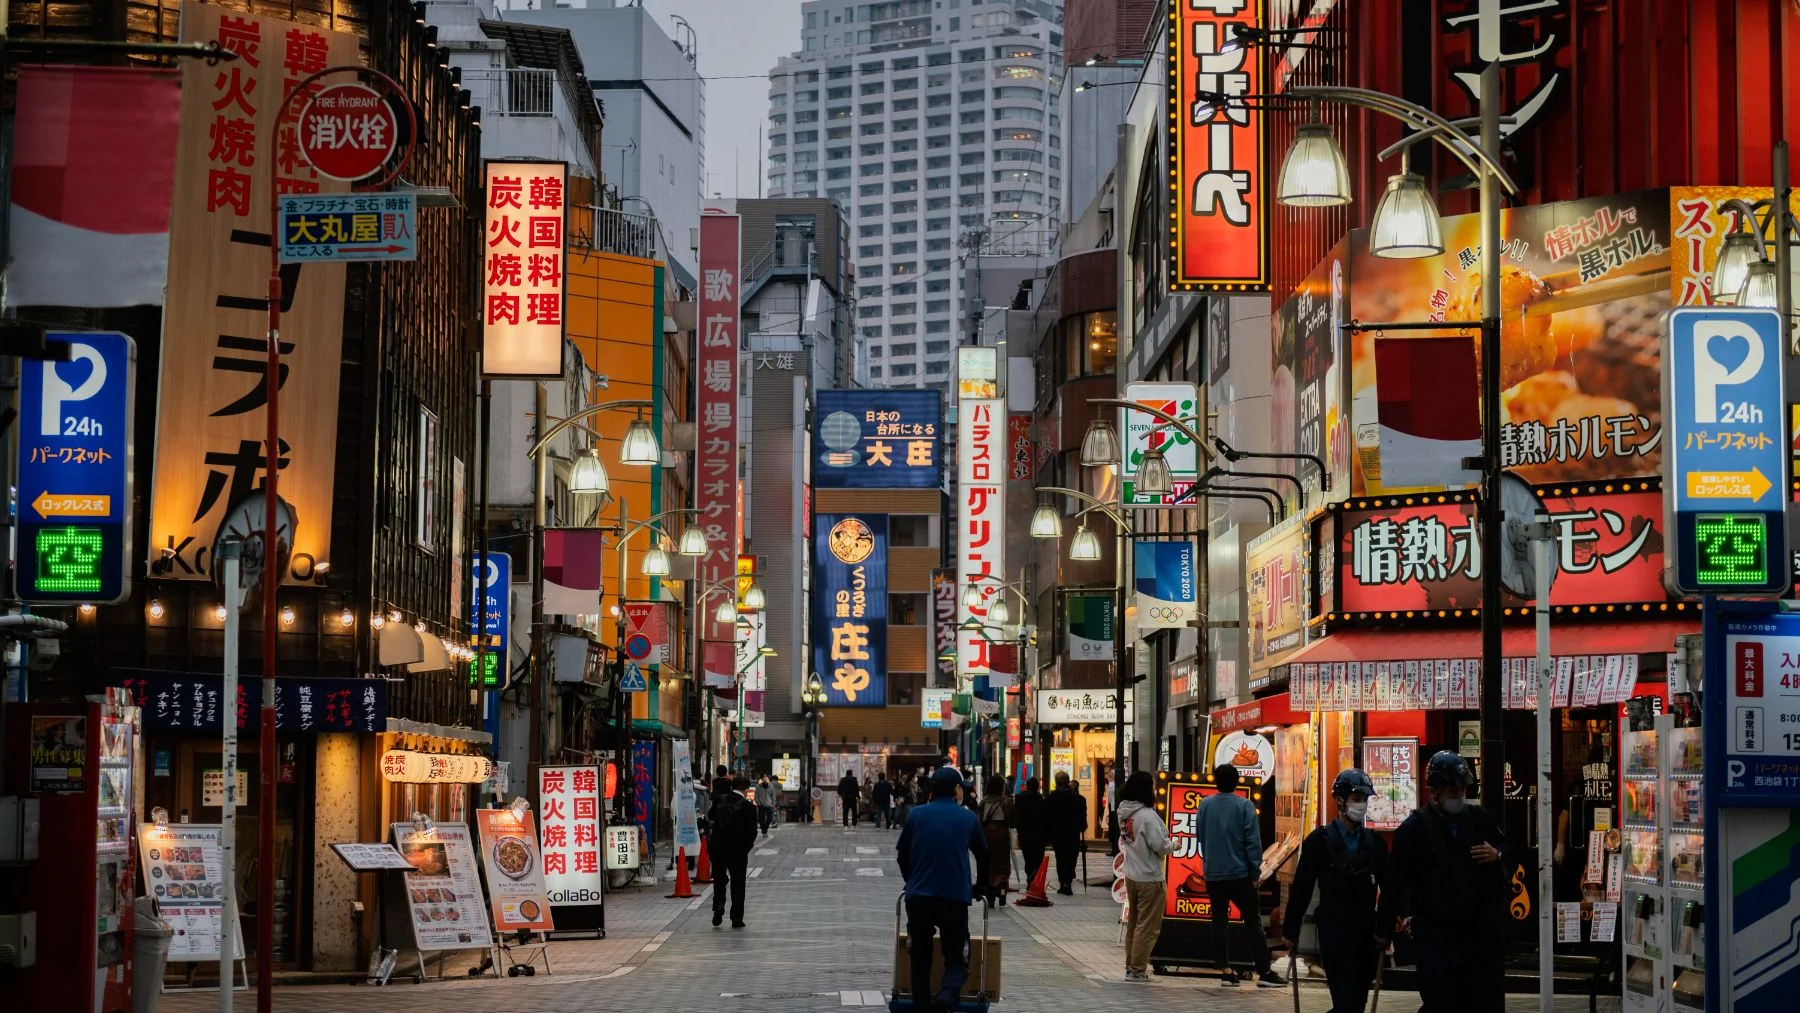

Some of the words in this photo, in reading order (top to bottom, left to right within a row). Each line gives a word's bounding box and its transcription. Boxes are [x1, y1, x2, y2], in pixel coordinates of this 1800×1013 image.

[316, 97, 336, 109] FIRE
[339, 92, 379, 109] HYDRANT
[207, 15, 261, 217] 炭火焼肉
[308, 113, 388, 150] 消火栓
[289, 213, 379, 244] 大丸屋
[383, 212, 411, 241] 買入
[1545, 205, 1637, 262] 情ホルで
[284, 246, 334, 258] ここ入る
[487, 176, 522, 326] 炭火焼肉
[527, 176, 562, 325] 韓国料理
[756, 352, 796, 371] 大雄
[865, 410, 901, 423] 日本の
[1300, 378, 1320, 429] EXTRA
[1719, 401, 1764, 425] 24h
[63, 416, 104, 436] 24h
[877, 424, 935, 436] 台所になる
[1130, 424, 1151, 432] SEVEN
[1684, 431, 1774, 451] パークネット
[30, 446, 112, 465] パークネット
[866, 440, 933, 467] 大庄
[1695, 484, 1752, 495] ロックレス式
[41, 499, 105, 511] ロックレス式
[35, 526, 103, 592] 空
[1352, 508, 1653, 586] 情熱ホモン
[1695, 515, 1763, 582] 空
[1180, 548, 1190, 578] TOKYO
[1181, 579, 1191, 600] 2020
[630, 609, 649, 617] 止まれ
[831, 621, 870, 703] 庄や
[1744, 648, 1755, 692] 最大料金
[157, 691, 169, 719] チキン
[170, 682, 182, 727] ヤンニョム
[1744, 709, 1755, 750] 通常料金
[541, 770, 567, 876] 炭火焼肉
[572, 770, 598, 874] 韓国料理
[616, 830, 629, 865] 豊田屋
[545, 888, 601, 904] KollaBo
